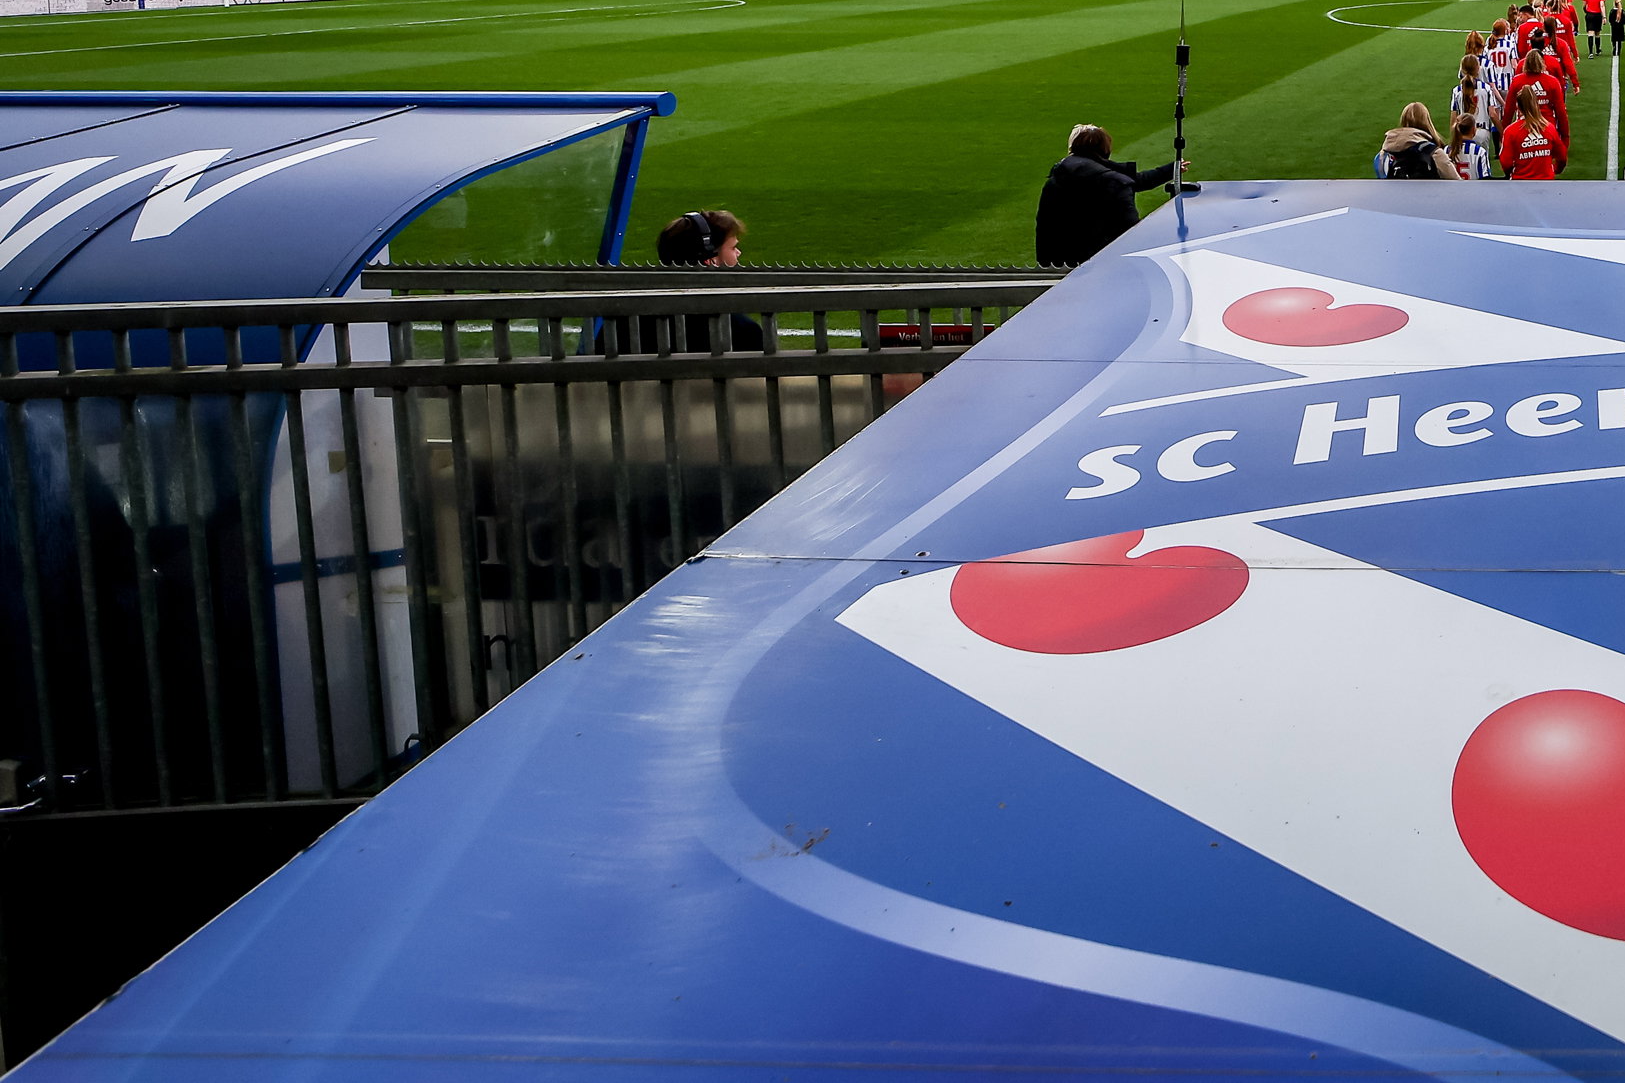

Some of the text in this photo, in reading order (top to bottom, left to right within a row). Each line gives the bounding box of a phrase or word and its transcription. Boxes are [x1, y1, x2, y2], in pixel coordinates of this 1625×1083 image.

[1490, 51, 1507, 68] 10
[1521, 138, 1548, 148] adidas
[898, 332, 945, 341] Verben
[1065, 429, 1237, 501] sc
